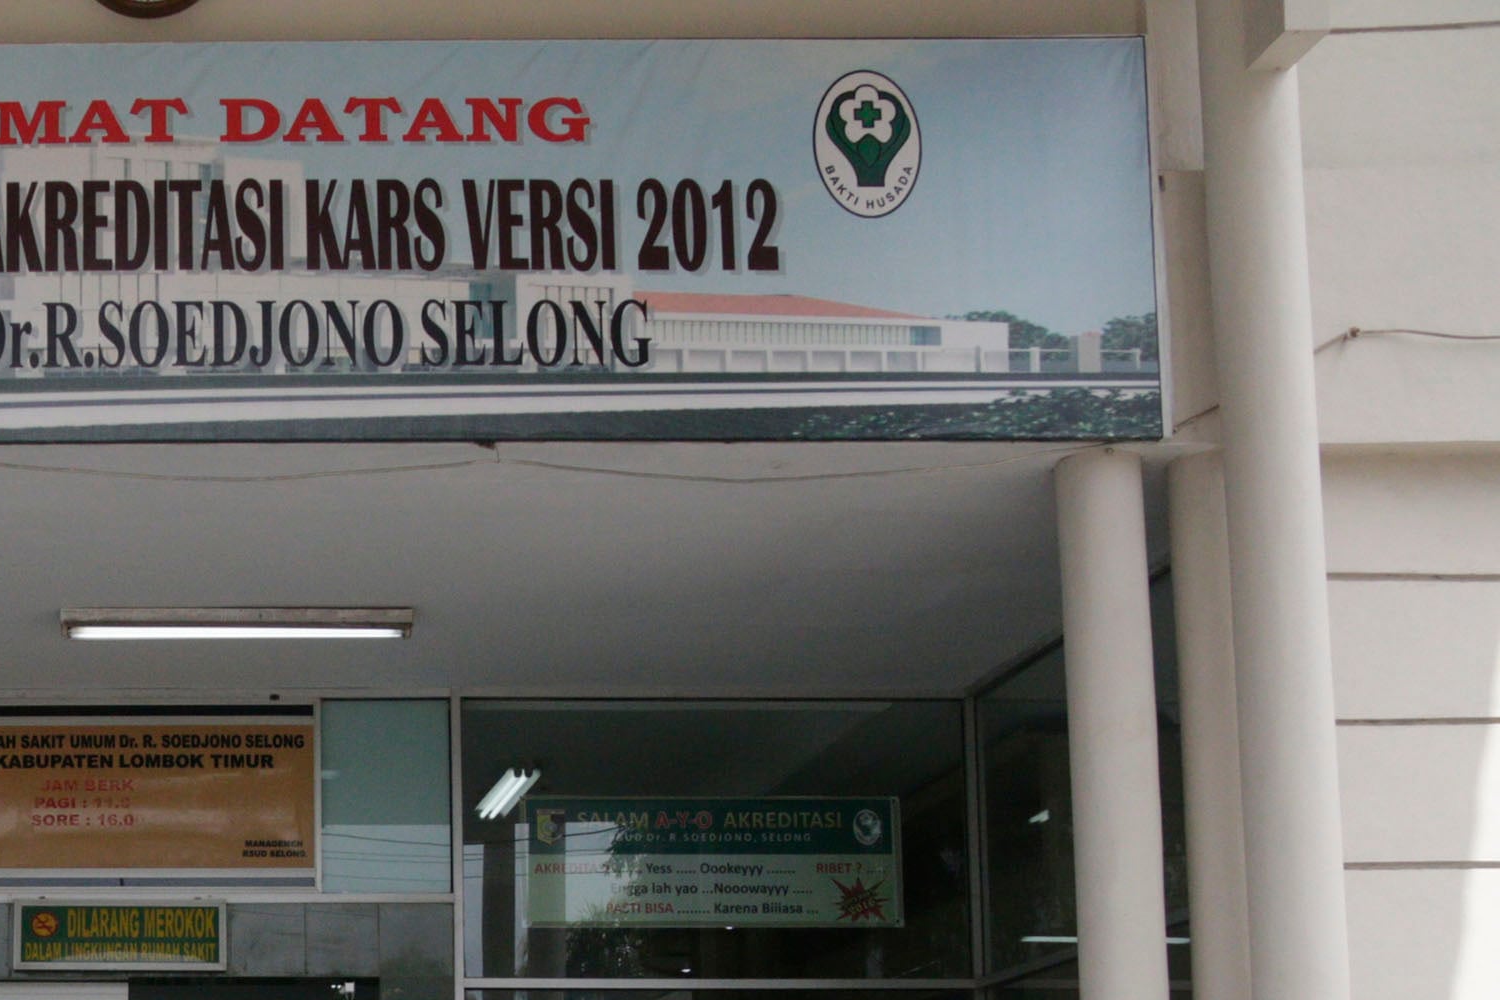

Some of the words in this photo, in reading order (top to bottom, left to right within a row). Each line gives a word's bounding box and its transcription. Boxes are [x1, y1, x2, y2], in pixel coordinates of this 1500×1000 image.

[219, 97, 592, 144] DATANG
[825, 165, 860, 206] BAKTI
[865, 165, 914, 209] HUSADA
[305, 177, 446, 272] KARS
[462, 177, 616, 272] VERSI
[636, 177, 780, 272] 2012
[420, 298, 652, 368] SELONG
[20, 734, 66, 749] SAKIT
[70, 734, 116, 749] UMUM
[119, 734, 138, 749] Dr.
[143, 734, 157, 749] R.
[161, 733, 241, 749] SOEDJONO
[245, 733, 305, 749] SELONG
[119, 754, 204, 769] LOMBOK
[210, 754, 274, 769] TIMUR
[41, 779, 78, 792] JAM
[34, 797, 77, 809] PAGI
[31, 813, 80, 826] SORE
[97, 813, 134, 826] 16.0
[655, 810, 713, 830] A-Y-O
[723, 810, 843, 829] AKREDITASI
[761, 833, 812, 843] SELONG
[645, 863, 673, 874] Yess
[815, 863, 852, 874] RIBET
[652, 882, 672, 894] lah
[675, 885, 699, 896] yao
[645, 902, 674, 914] BISA
[714, 903, 758, 914] Karena
[67, 907, 140, 938] DILARANG
[143, 907, 216, 938] MEROKOK
[24, 942, 62, 961] DALAM
[65, 942, 138, 961] LINGKUNGAN
[141, 942, 181, 961] RUMAH
[183, 942, 216, 961] SAKIT
